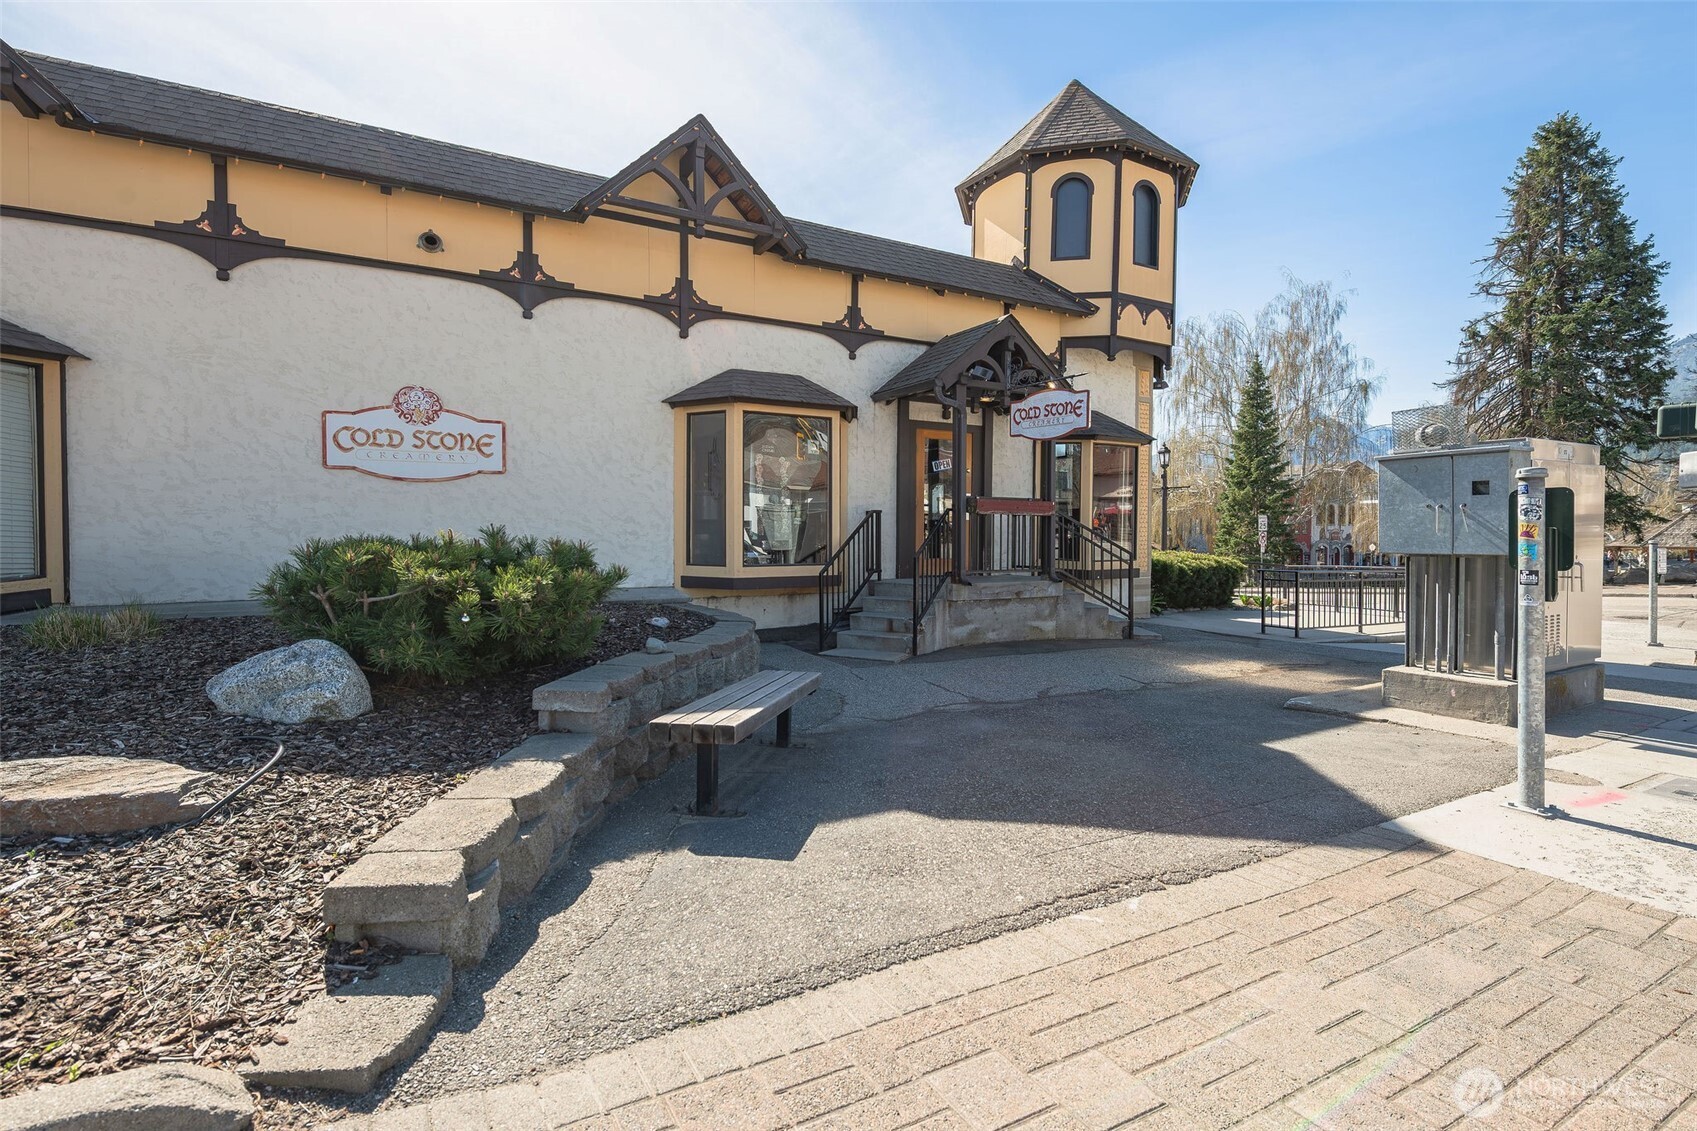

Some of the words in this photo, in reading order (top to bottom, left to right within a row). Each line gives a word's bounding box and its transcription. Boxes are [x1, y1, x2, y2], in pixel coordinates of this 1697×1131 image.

[1013, 406, 1041, 426] COLD
[1044, 399, 1084, 418] STONE
[332, 426, 404, 453] COLD
[411, 428, 496, 458] STONE
[366, 450, 468, 462] CREAMERY
[933, 459, 951, 471] OPEN
